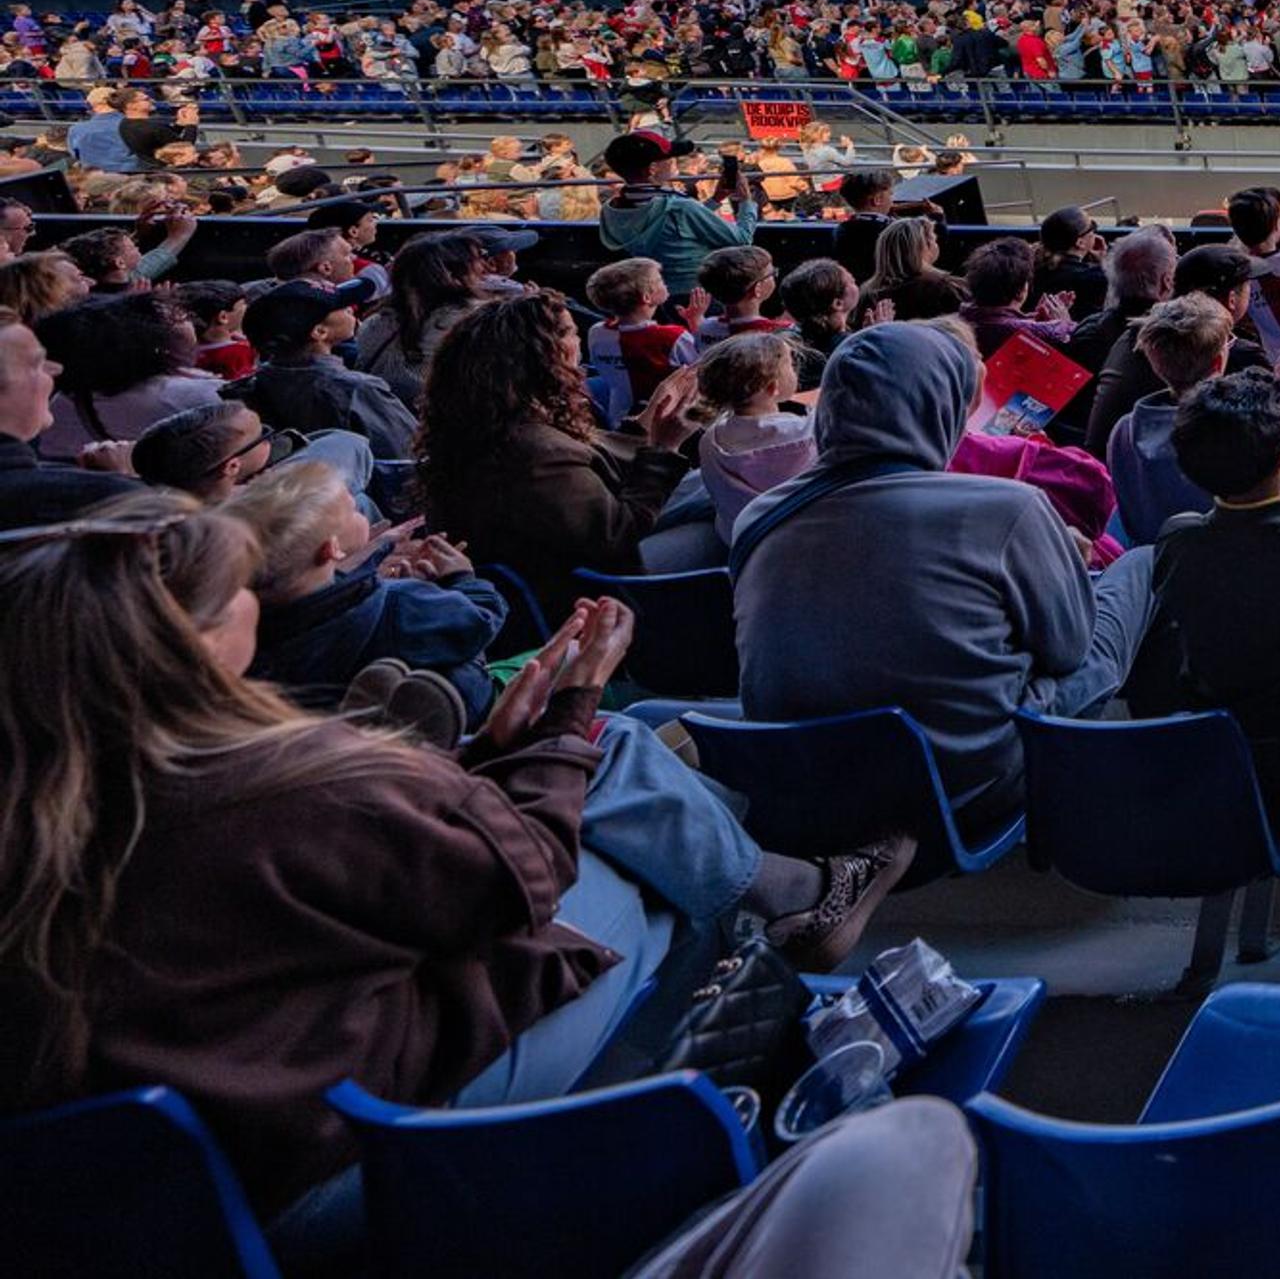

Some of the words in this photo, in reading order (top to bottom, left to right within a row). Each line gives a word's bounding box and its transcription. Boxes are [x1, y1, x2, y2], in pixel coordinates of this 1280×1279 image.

[747, 103, 763, 115] DE
[764, 103, 795, 116] KUIP
[796, 103, 811, 116] IS
